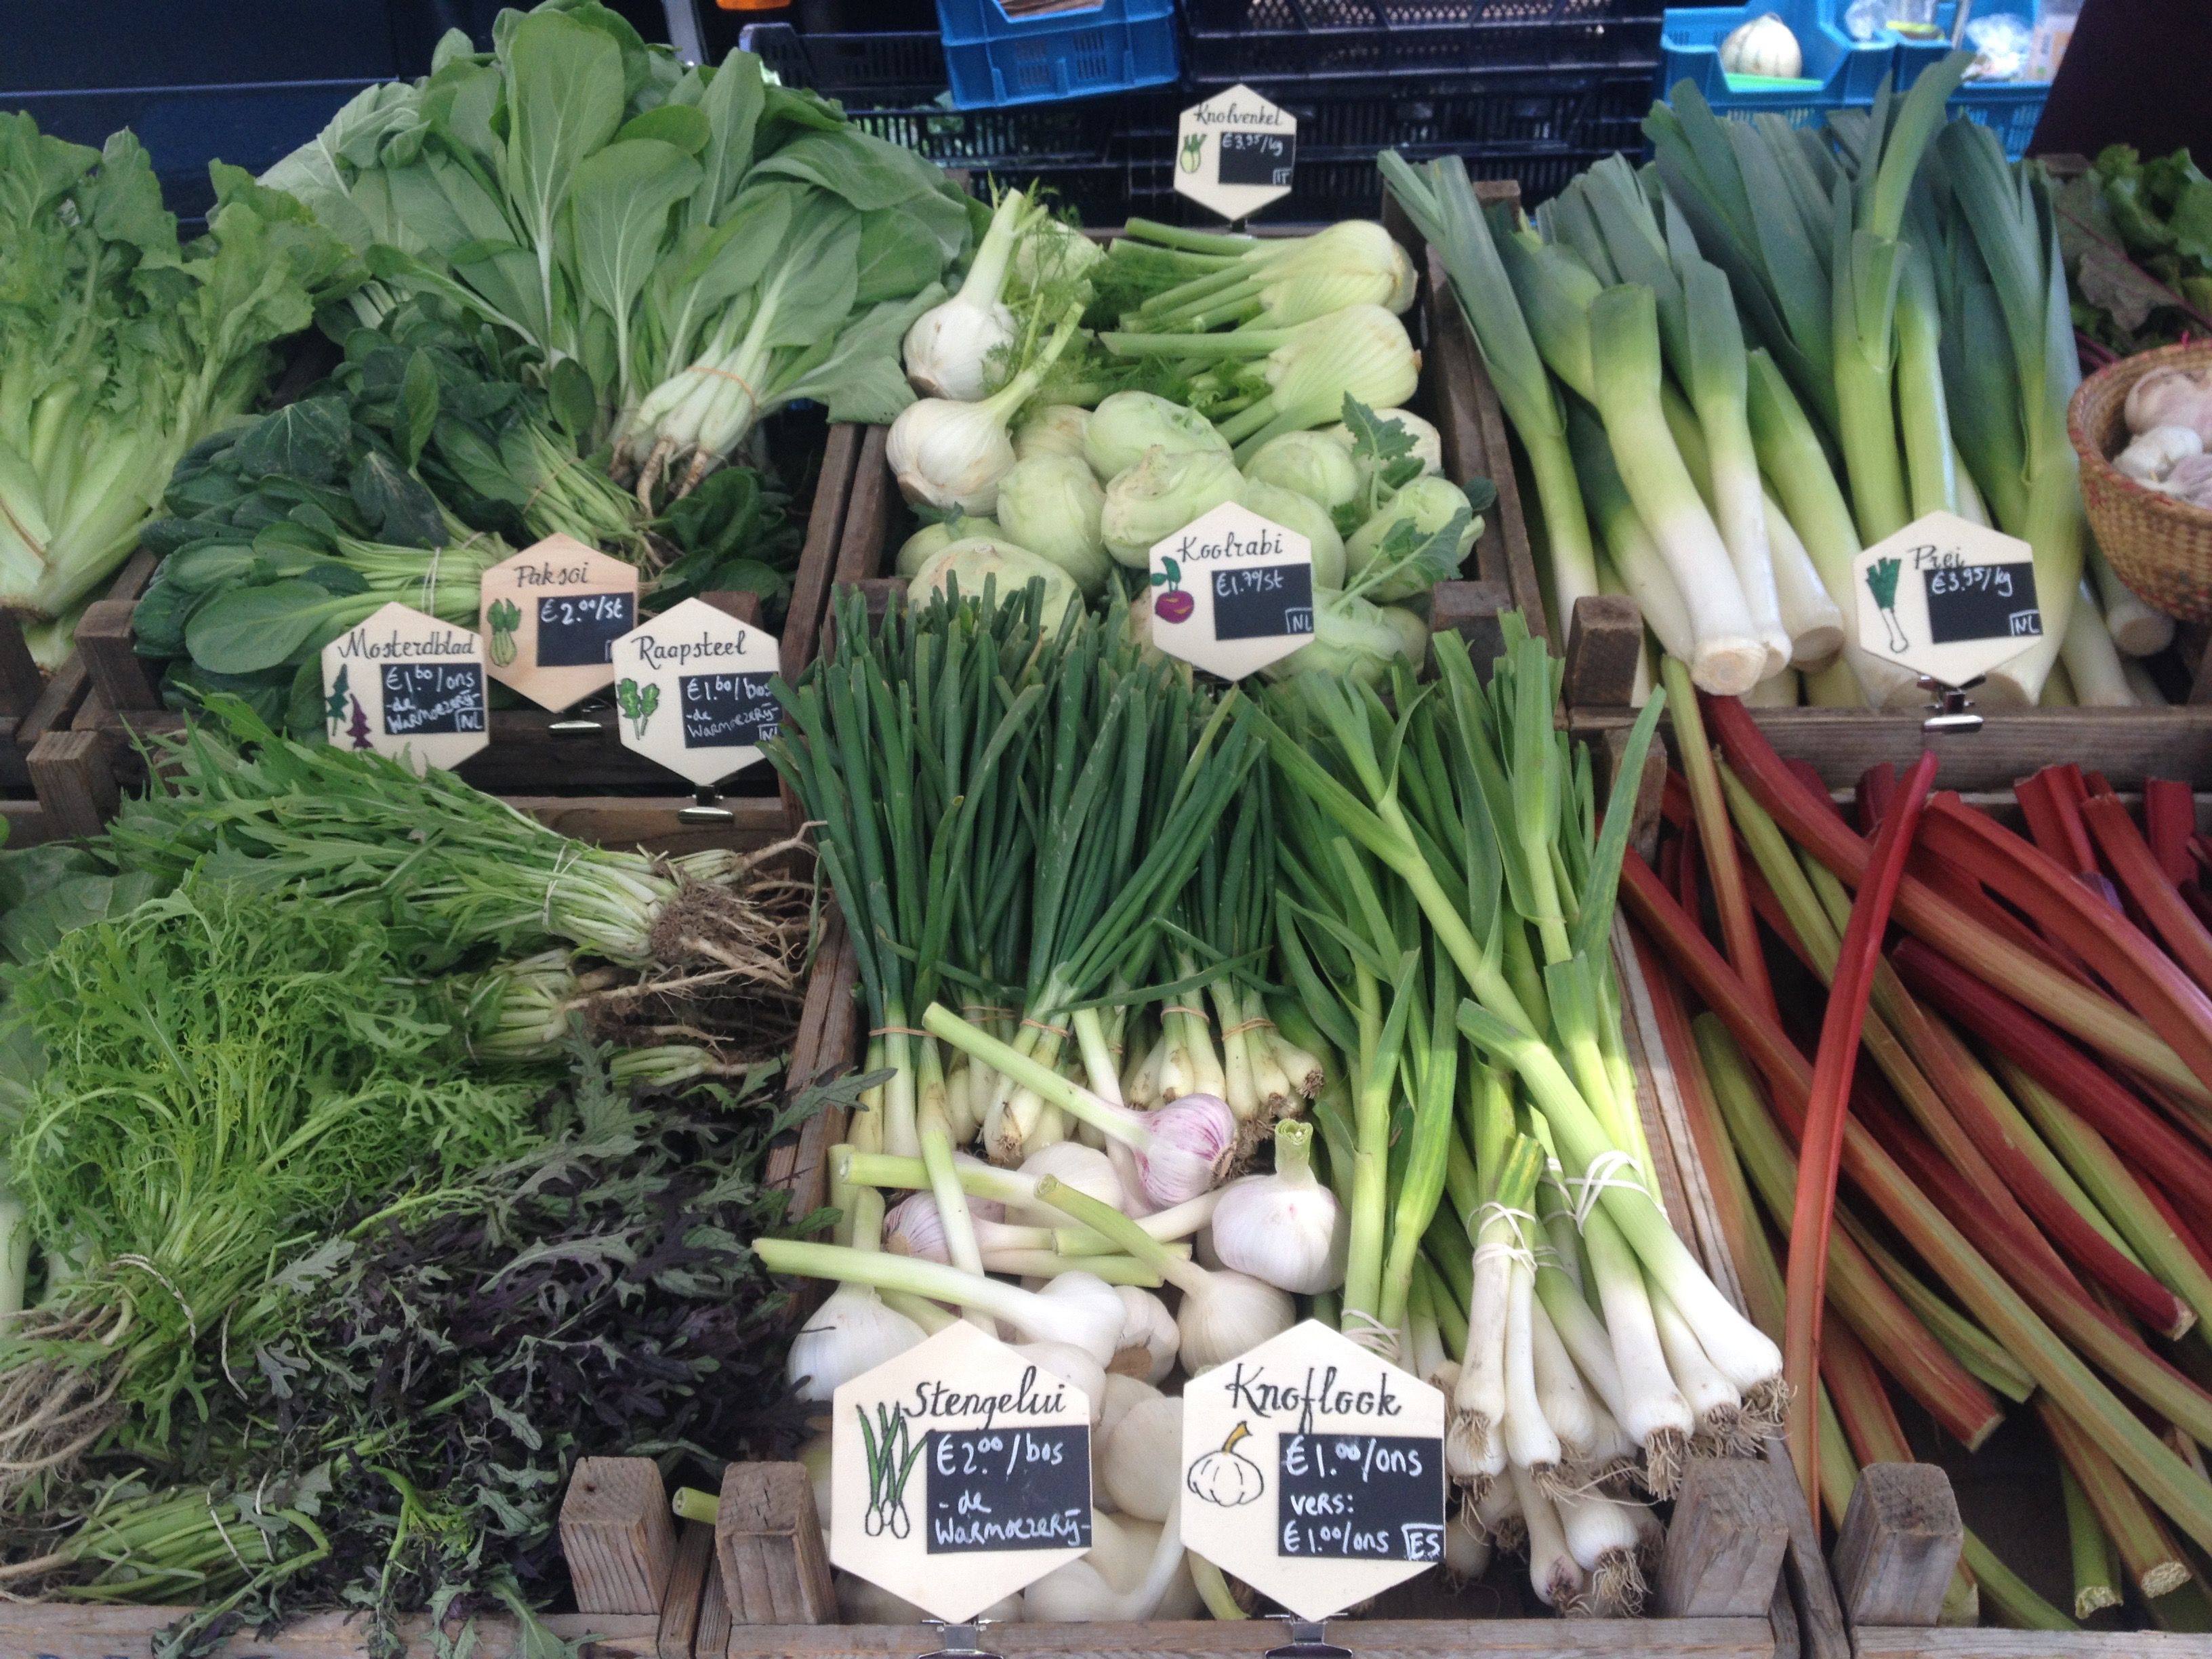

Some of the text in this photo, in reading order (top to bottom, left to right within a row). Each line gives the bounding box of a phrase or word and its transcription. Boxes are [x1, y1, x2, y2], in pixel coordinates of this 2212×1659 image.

[1193, 102, 1284, 126] Knolvenkel
[1176, 529, 1283, 563] Koolrabi
[1906, 544, 1966, 570] Prei
[1292, 613, 1313, 632] NL
[2015, 614, 2040, 634] NL
[337, 628, 476, 660] Mosterdblad
[630, 630, 747, 670] Raapsteel
[459, 712, 483, 730] NL
[902, 1365, 1067, 1430] Stengelui
[1225, 1362, 1402, 1435] Knoflook
[1409, 1531, 1441, 1559] ES
